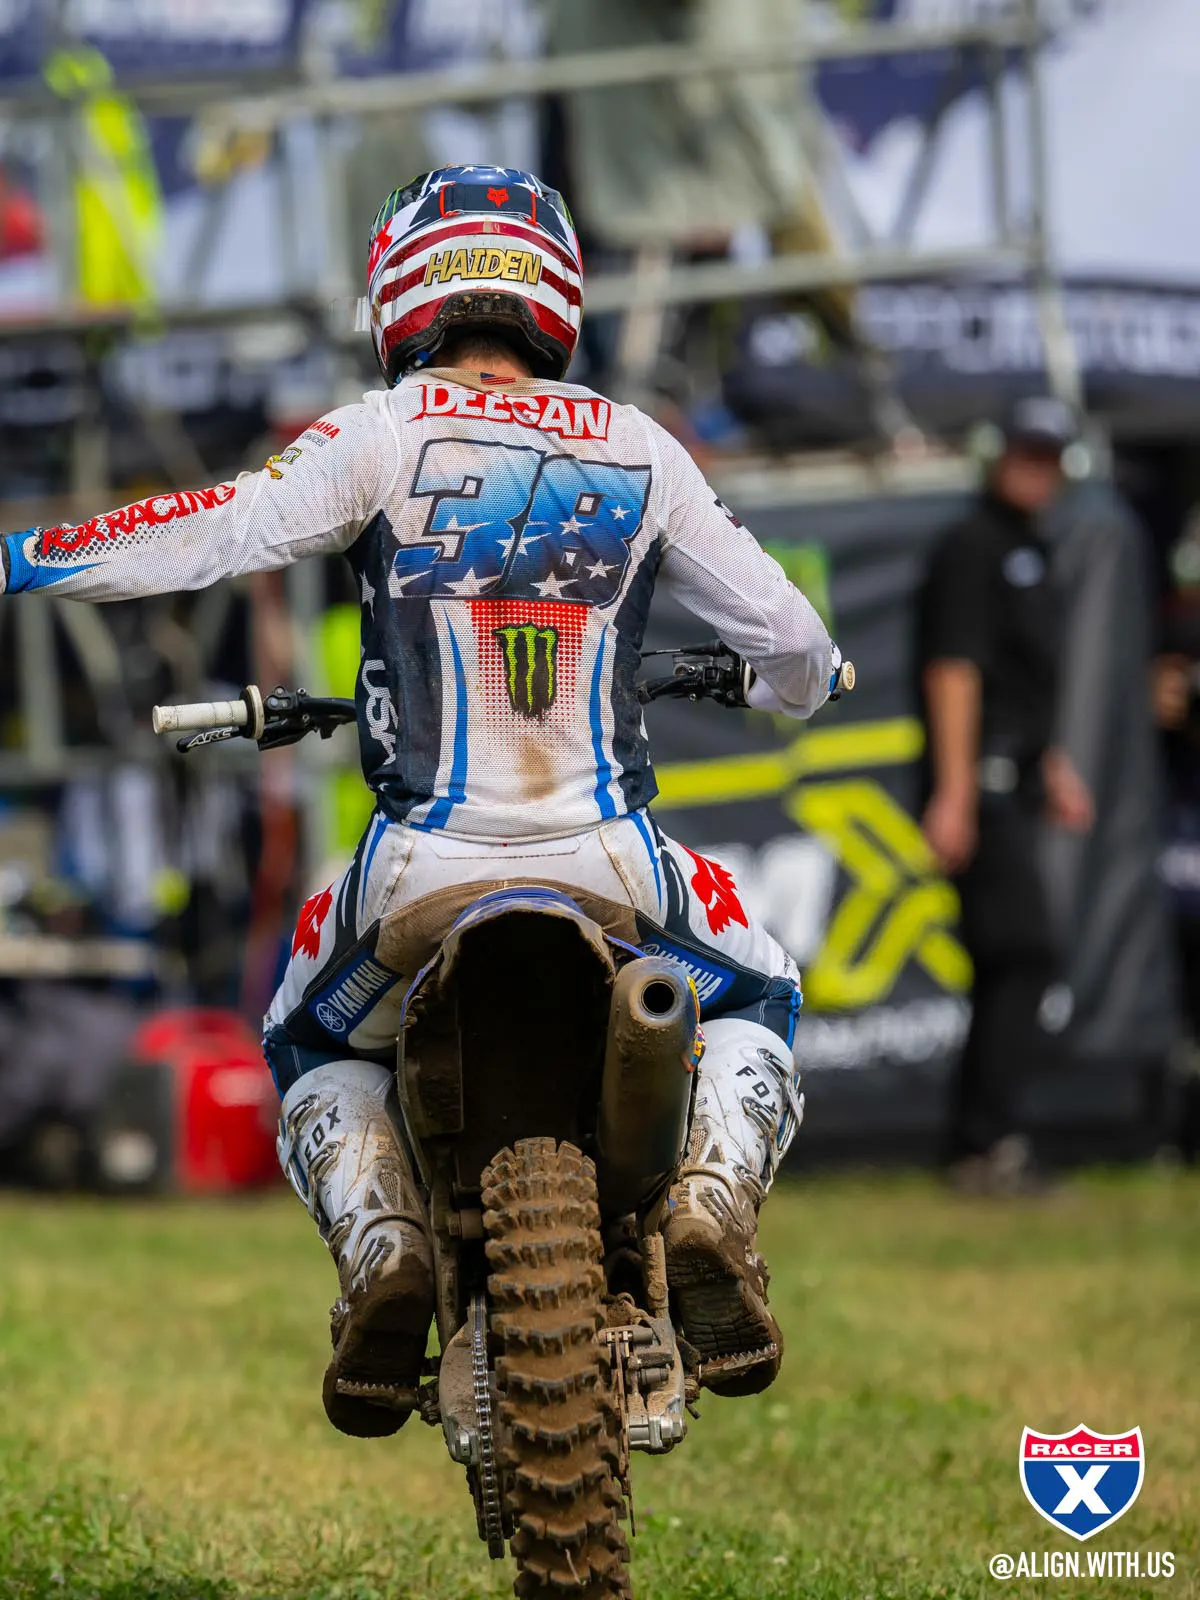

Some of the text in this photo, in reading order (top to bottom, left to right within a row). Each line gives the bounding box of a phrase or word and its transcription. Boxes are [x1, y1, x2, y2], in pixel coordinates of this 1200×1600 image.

[424, 247, 542, 287] HAIDEN
[422, 383, 611, 440] DEEGAN
[42, 484, 236, 556] FOX RACING
[389, 438, 652, 610] 38
[327, 959, 393, 1019] YAMAHA
[735, 1065, 779, 1115] FOX
[303, 1105, 342, 1163] FOX
